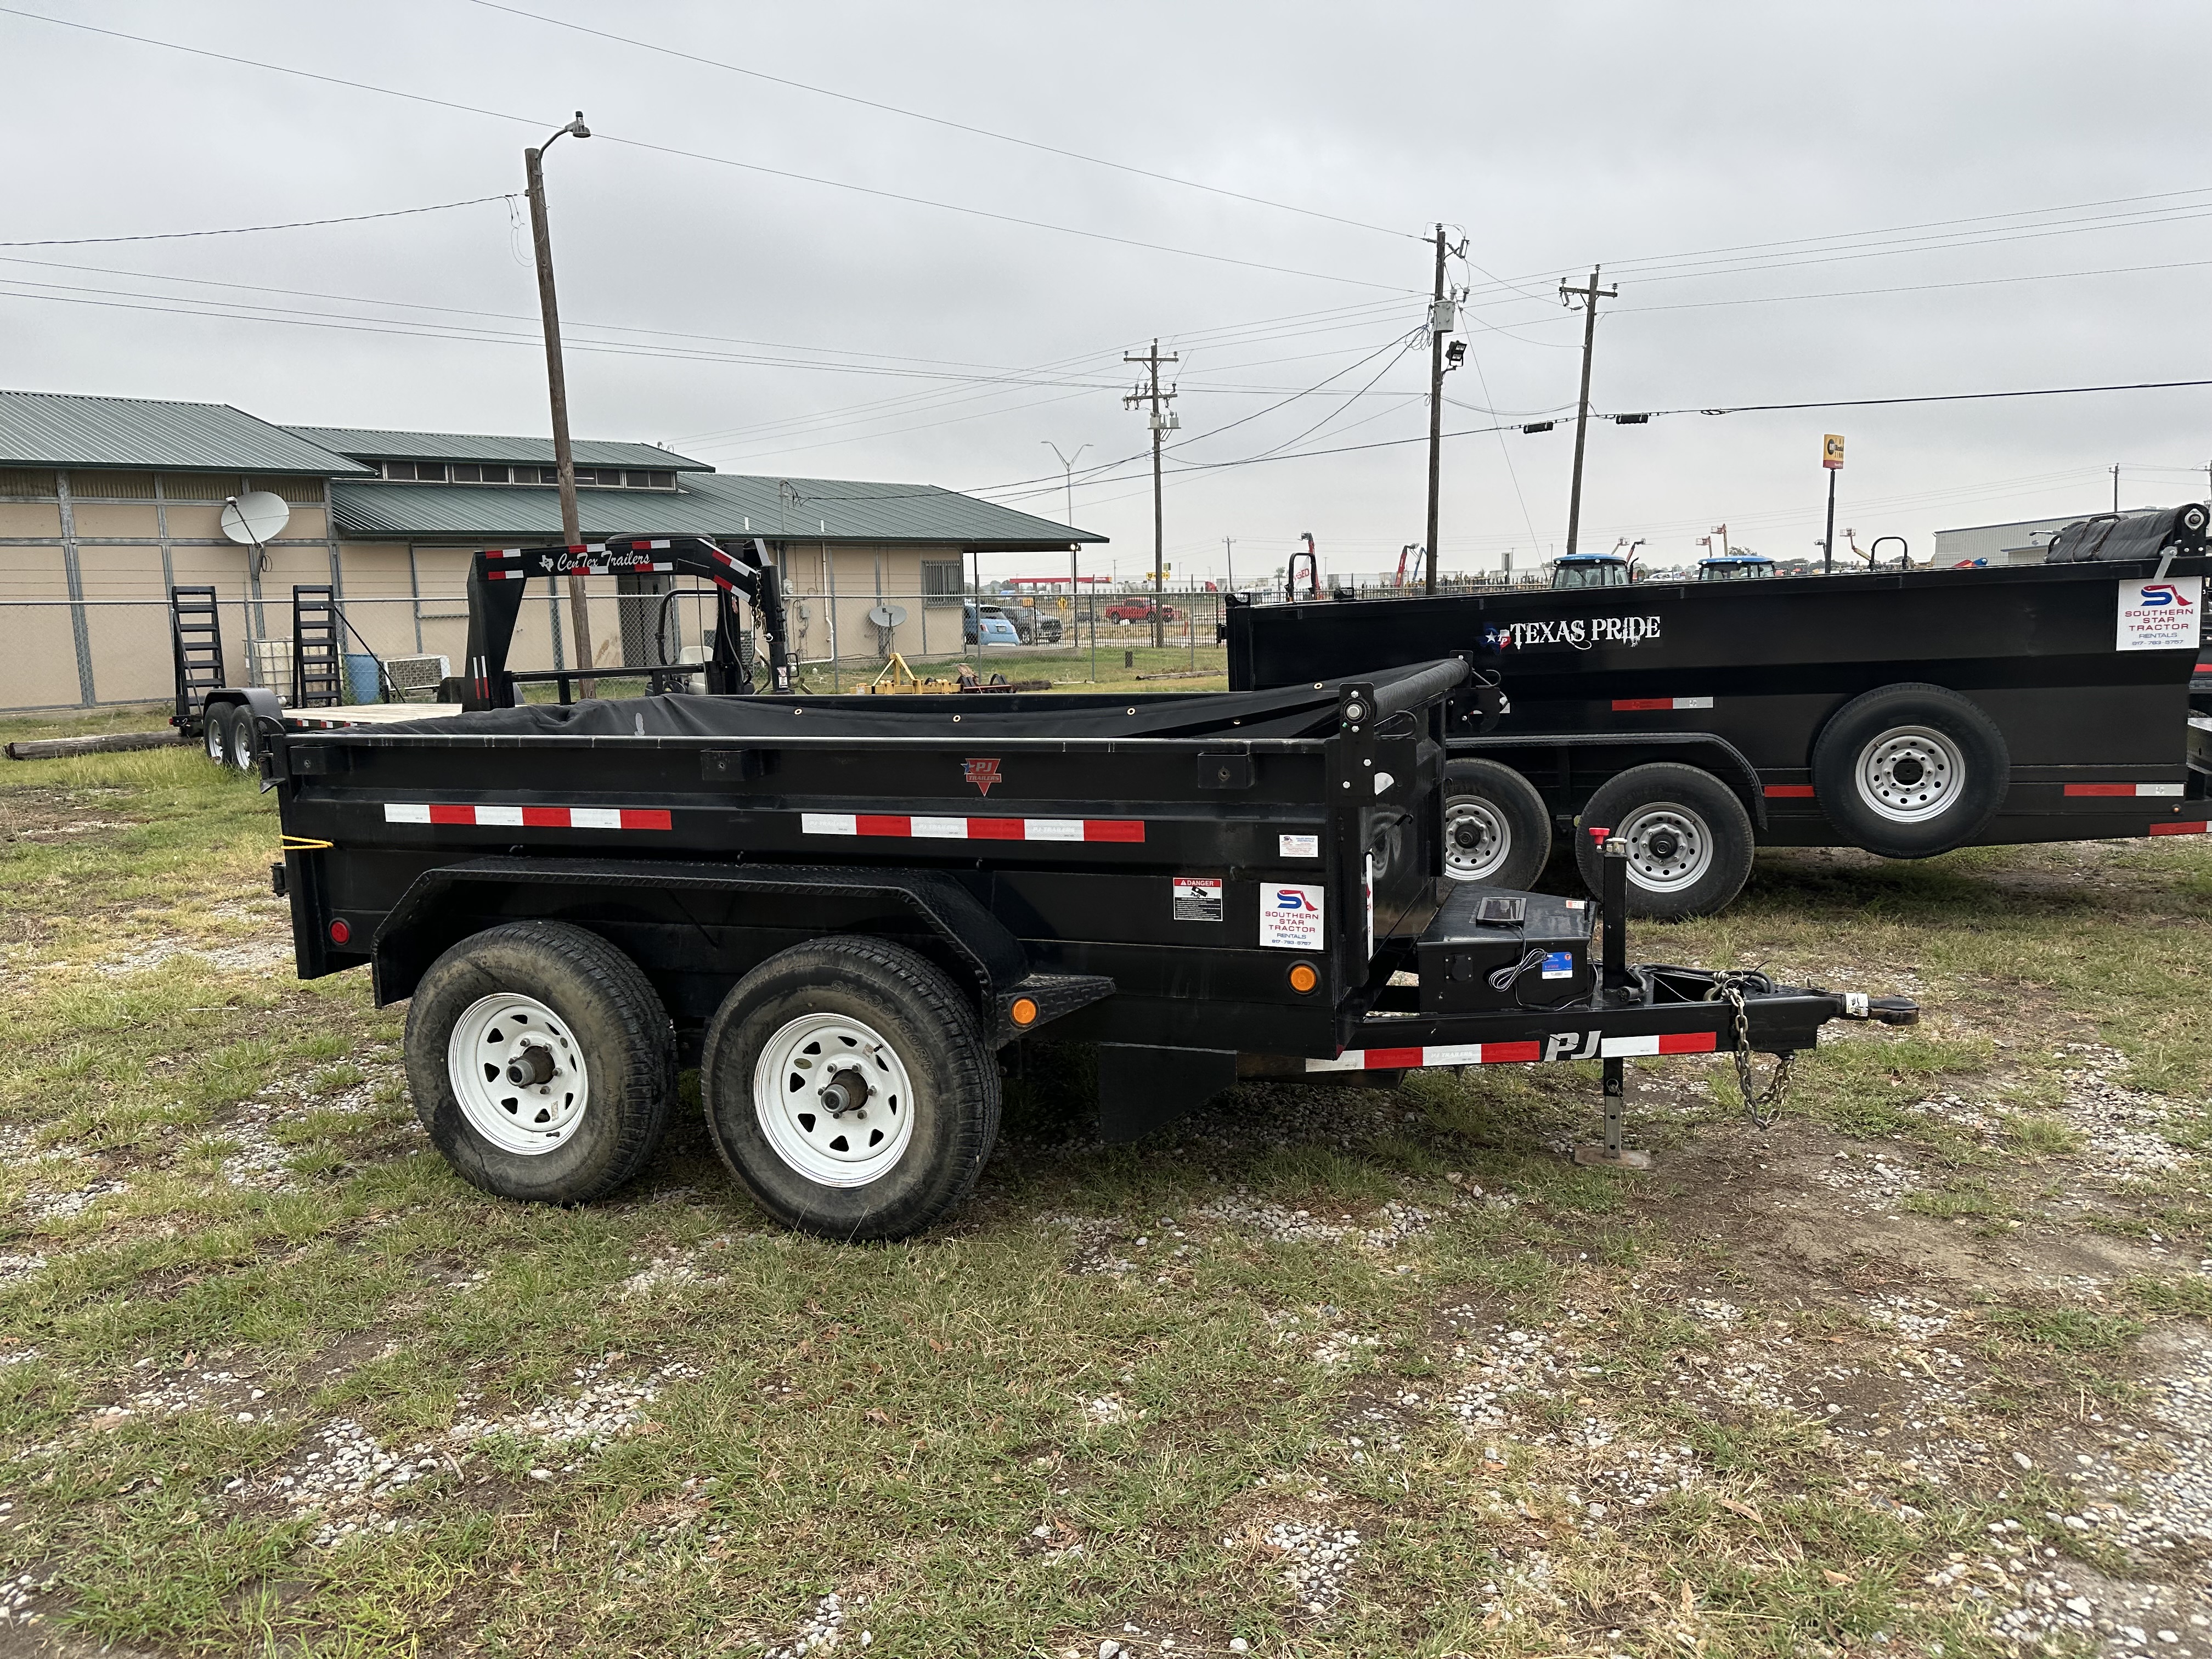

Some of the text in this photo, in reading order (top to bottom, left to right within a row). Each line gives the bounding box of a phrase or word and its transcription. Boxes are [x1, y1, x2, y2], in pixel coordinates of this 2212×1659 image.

[601, 550, 651, 567] Trailers
[2125, 608, 2193, 617] SOUTHERN
[1510, 616, 1661, 650] TEXAS PRIDE
[975, 761, 993, 772] PJ
[1265, 911, 1319, 919] SOUTHERN
[1268, 924, 1316, 933] TRACTOR
[1544, 1030, 1602, 1062] PJ
